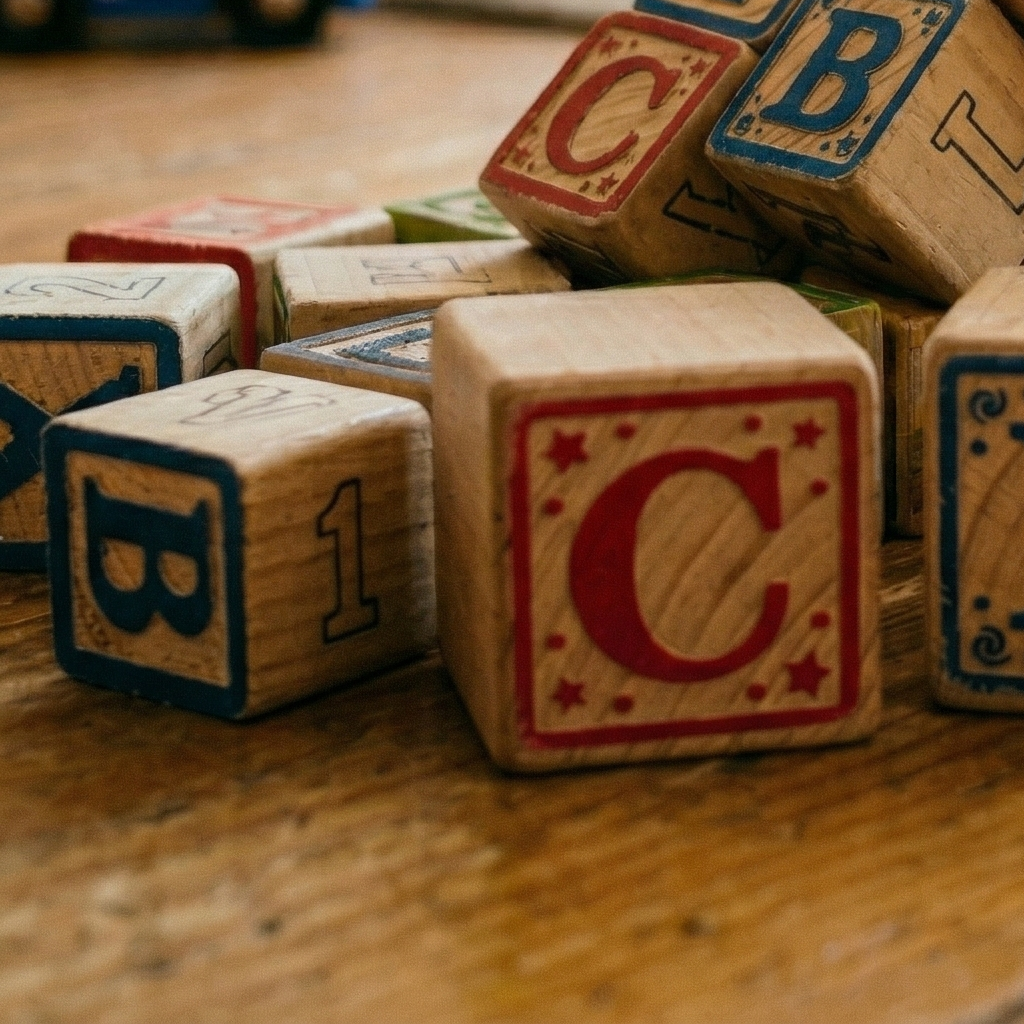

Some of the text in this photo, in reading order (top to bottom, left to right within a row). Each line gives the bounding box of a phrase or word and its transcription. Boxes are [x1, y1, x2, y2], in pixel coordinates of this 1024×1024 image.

[545, 53, 684, 177] C
[759, 7, 905, 136] B
[82, 474, 214, 637] B
[316, 476, 380, 645] 1
[568, 444, 790, 684] C
